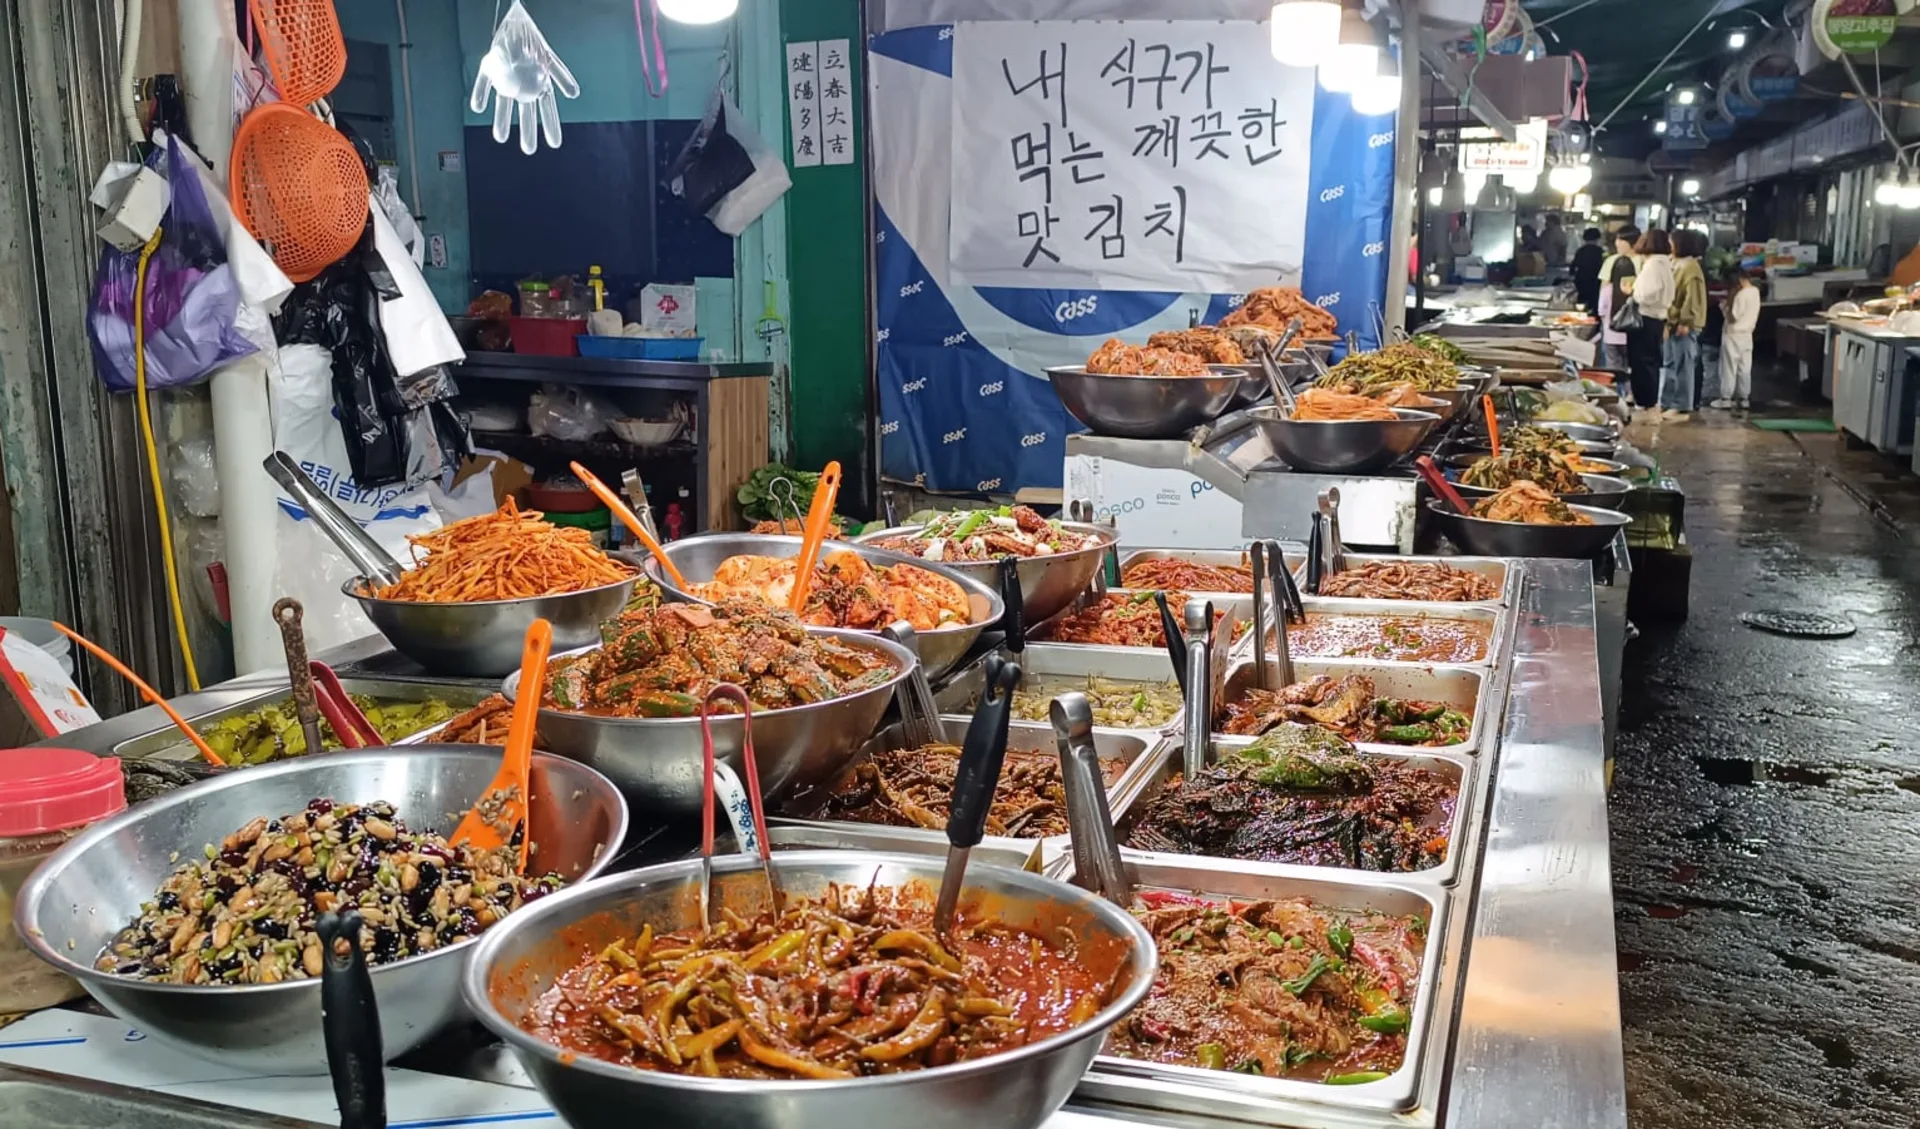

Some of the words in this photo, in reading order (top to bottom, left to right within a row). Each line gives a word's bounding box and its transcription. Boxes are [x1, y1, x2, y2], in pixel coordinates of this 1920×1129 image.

[792, 52, 815, 156] 建陽多慶
[824, 50, 848, 154] 立春大吉
[1002, 42, 1067, 128] 내
[1101, 38, 1230, 110] 식구가
[1011, 122, 1105, 204] 먹는
[1132, 98, 1287, 168] 깨끗한
